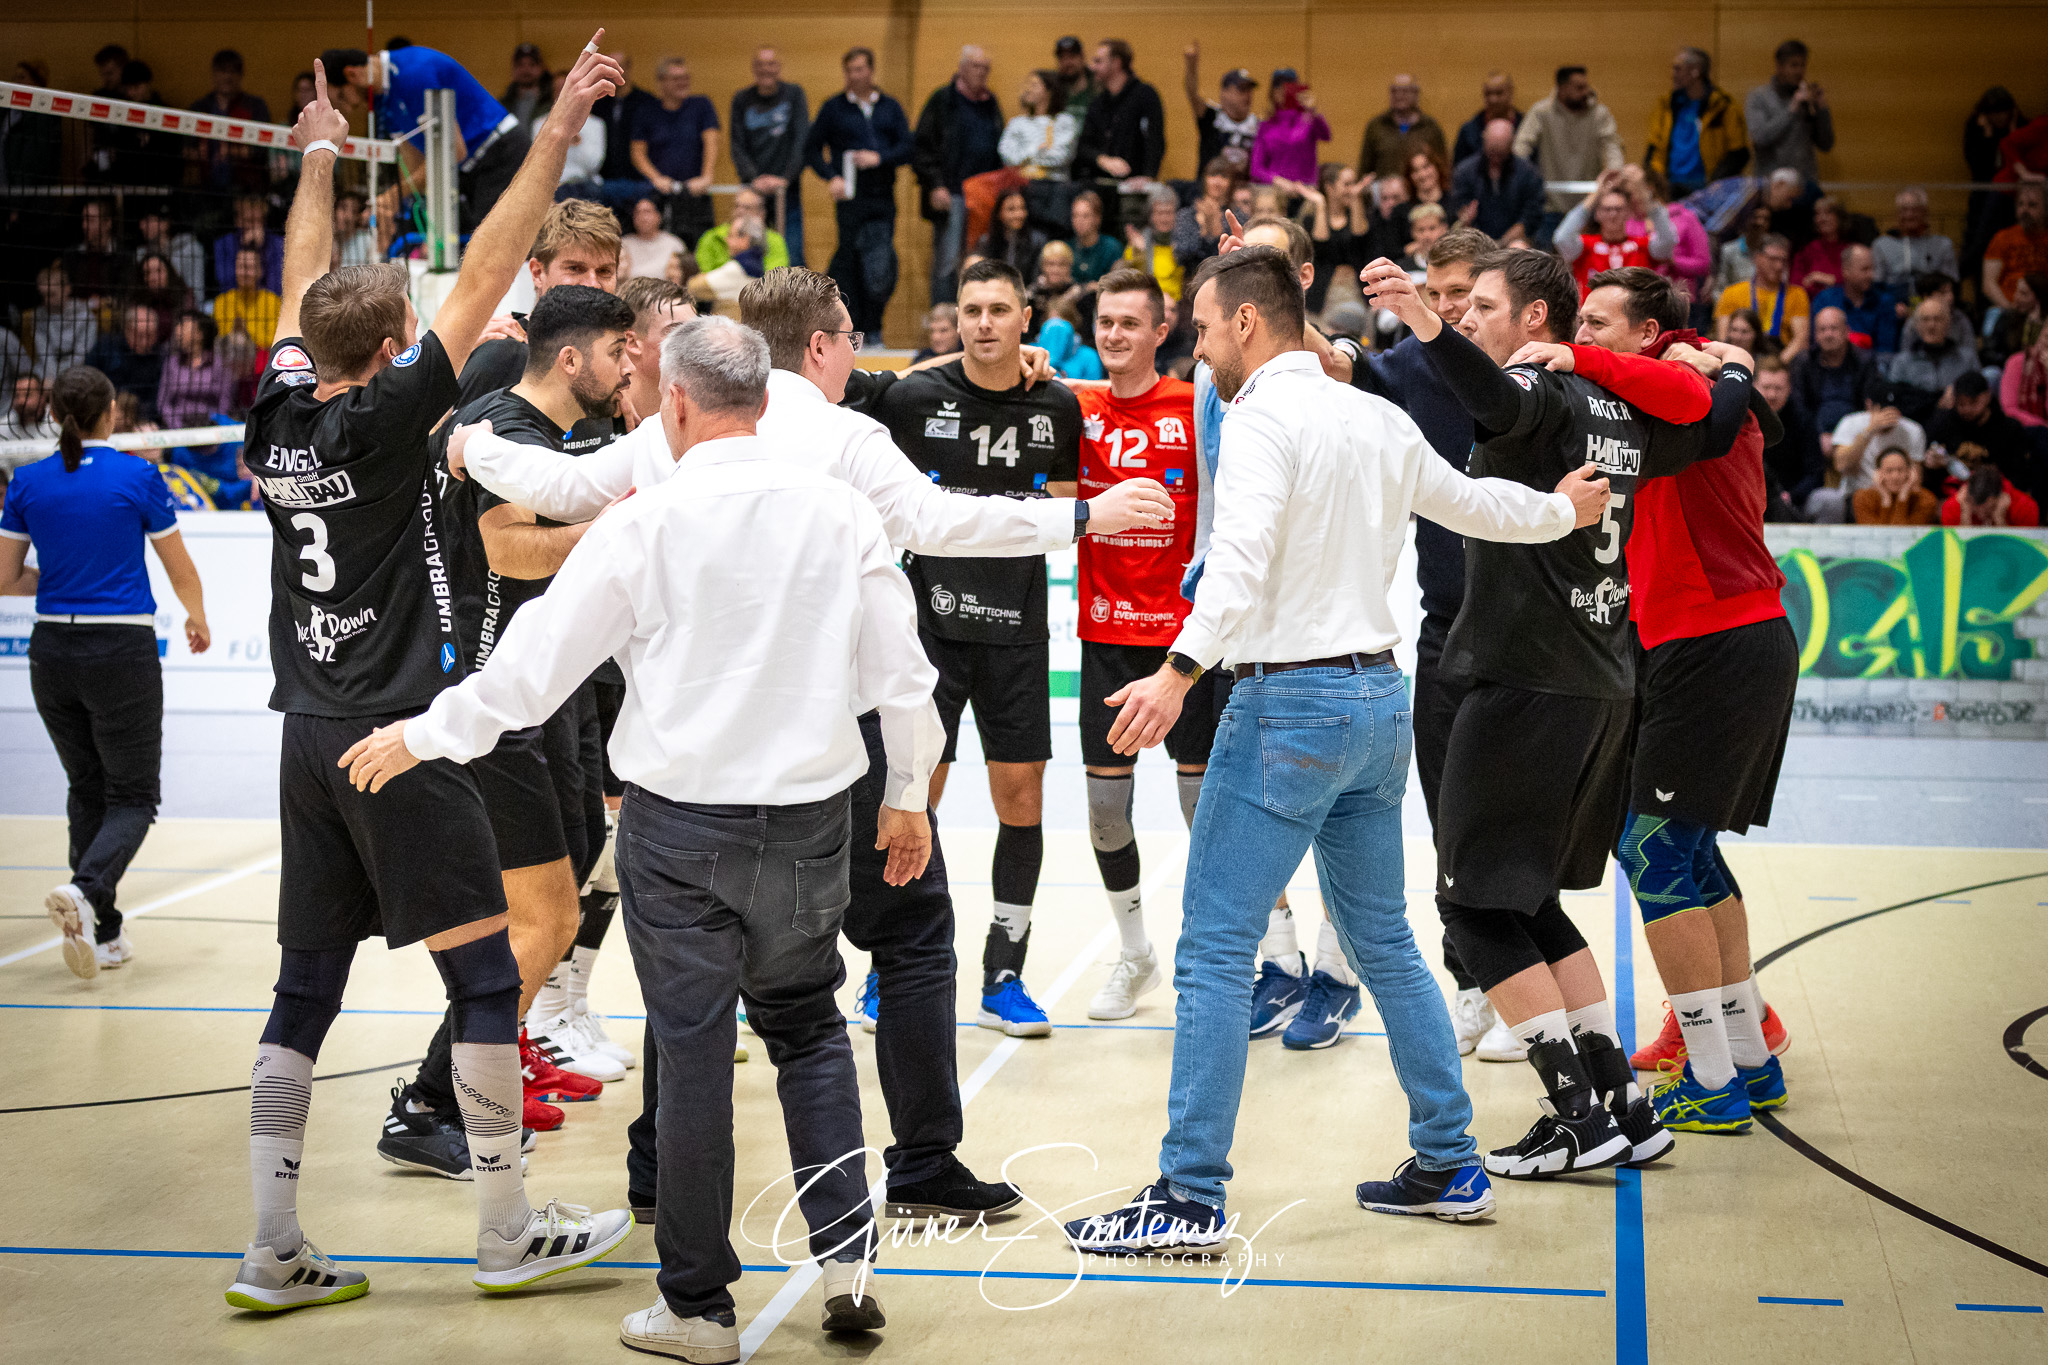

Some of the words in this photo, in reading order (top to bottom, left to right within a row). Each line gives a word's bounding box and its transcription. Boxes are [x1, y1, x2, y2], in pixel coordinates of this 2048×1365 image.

[1587, 395, 1632, 420] RICTR
[1028, 414, 1055, 443] 1A
[1154, 416, 1188, 444] 1A
[563, 436, 602, 450] MBRAGROUP
[969, 425, 1021, 467] 14
[1104, 428, 1149, 468] 12
[296, 471, 320, 483] GmbH
[302, 474, 350, 504] BAU
[1594, 492, 1626, 564] 5
[290, 512, 336, 592] 3
[961, 593, 979, 605] VSL
[1116, 600, 1134, 611] VSL
[1571, 587, 1594, 608] Pose
[325, 607, 378, 638] Down
[229, 639, 270, 661] FÜ
[1681, 1018, 1713, 1028] erima
[1722, 1008, 1746, 1017] rima
[274, 1171, 299, 1180] erim
[476, 1163, 512, 1173] erima
